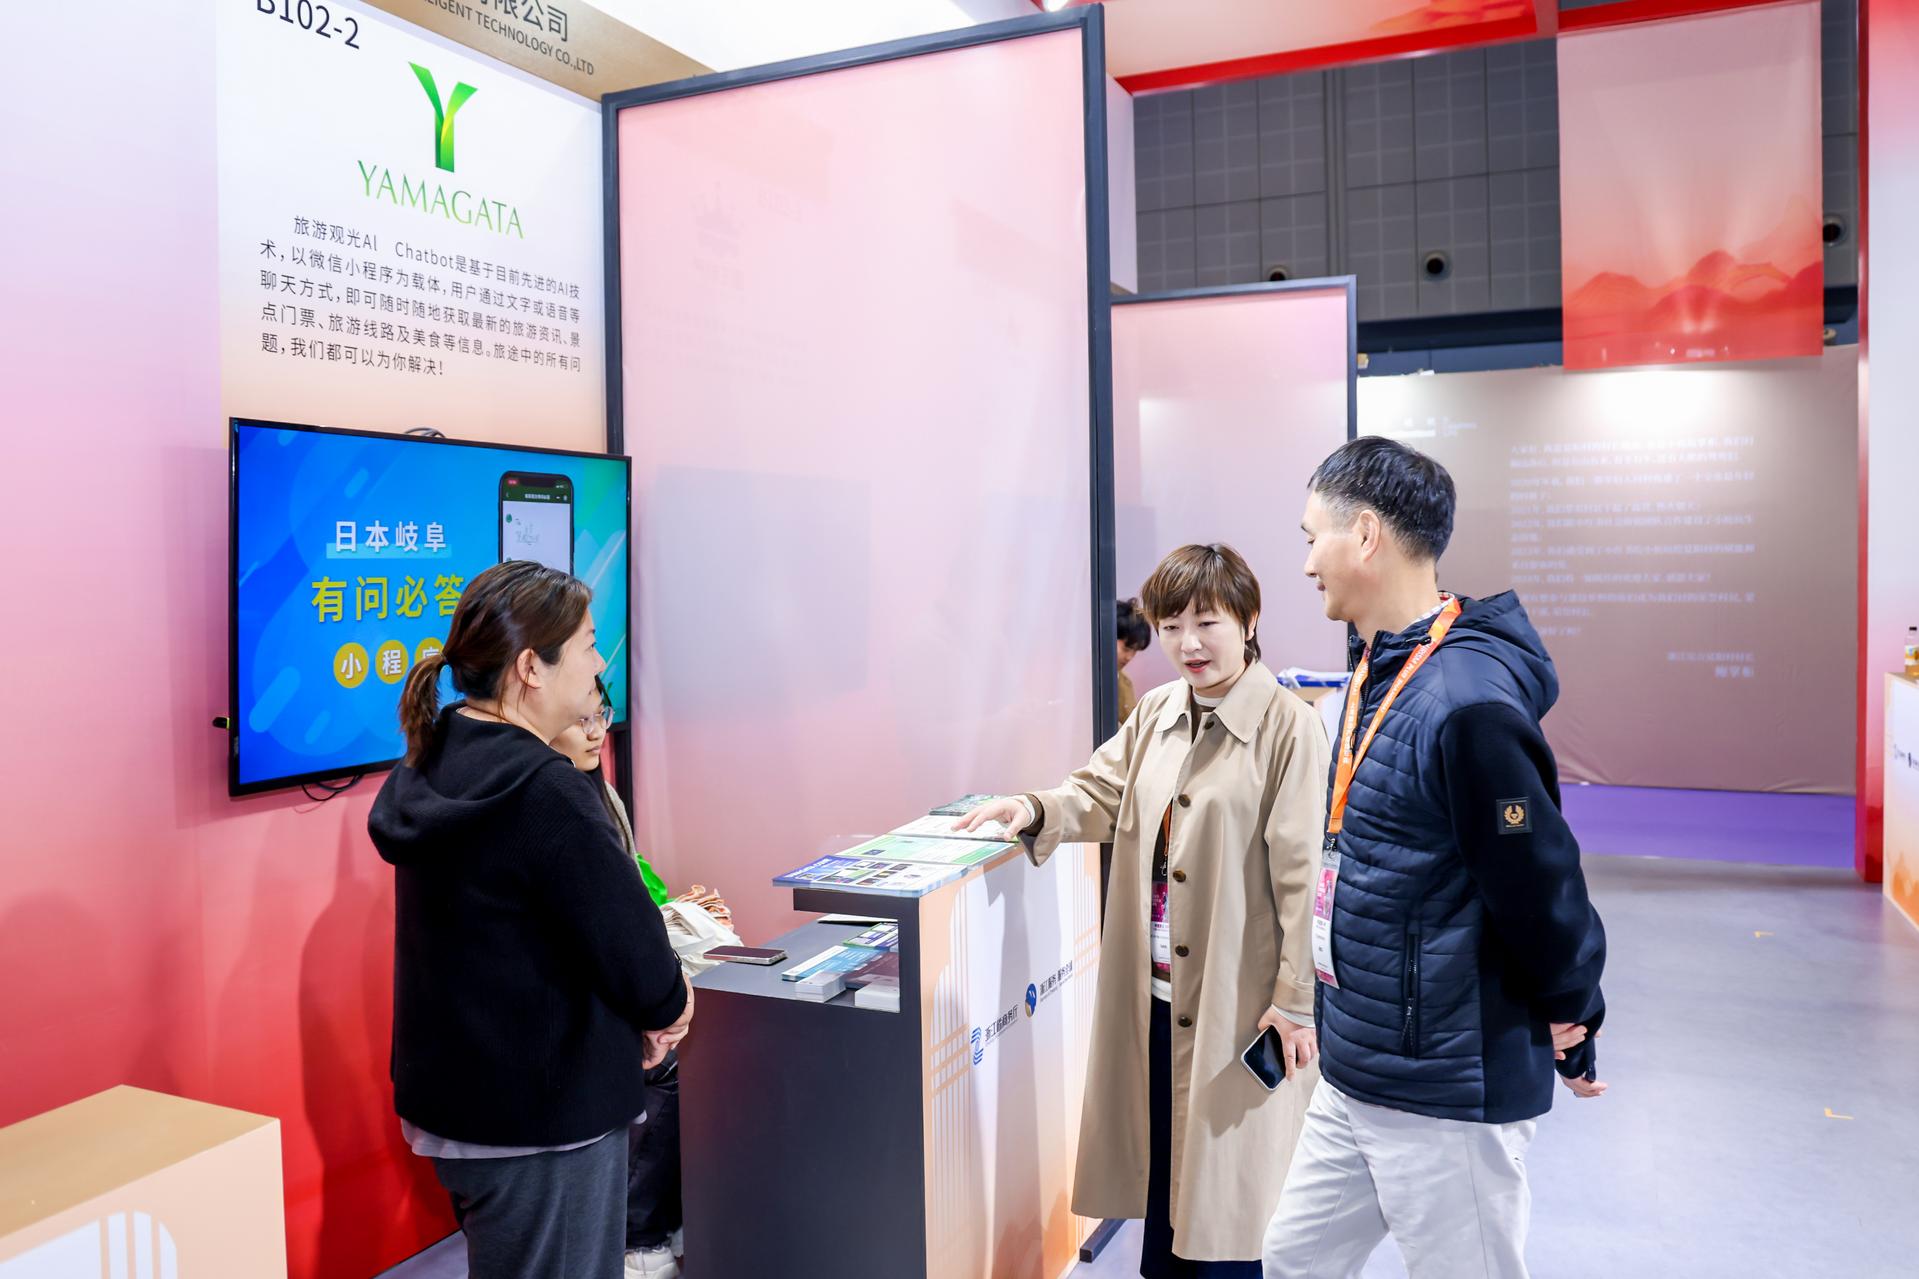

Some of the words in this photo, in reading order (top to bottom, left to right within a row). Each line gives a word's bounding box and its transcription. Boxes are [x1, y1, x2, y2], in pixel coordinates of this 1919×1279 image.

[475, 10, 554, 57] TECHNOLOGY
[555, 48, 595, 76] CO.,LTD
[357, 159, 525, 240] YAMAGATA
[294, 215, 378, 252] 旅游观光AI
[335, 520, 447, 553] 日本岐阜
[311, 574, 465, 622] 有问必答
